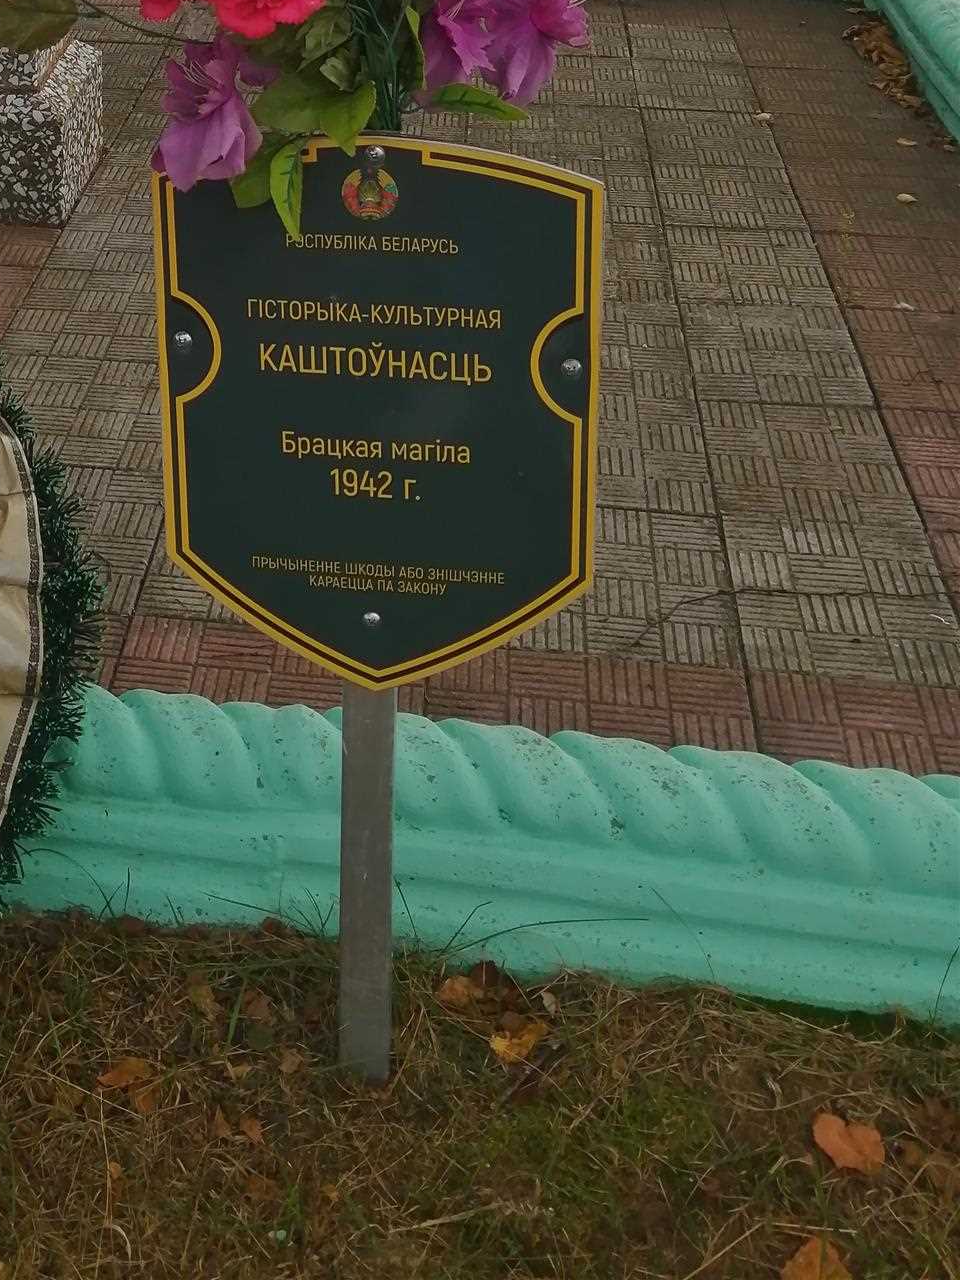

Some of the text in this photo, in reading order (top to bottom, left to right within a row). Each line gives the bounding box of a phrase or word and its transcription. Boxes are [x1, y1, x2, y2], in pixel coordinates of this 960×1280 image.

[382, 236, 459, 254] БЕЛАРУСЬ
[246, 298, 502, 329] ГІСТОРЫКА-КУЛЬТУРНАЯ
[259, 343, 492, 384] КАШТОЎНАСЦЬ
[281, 431, 471, 465] Брацкая магіла
[329, 469, 422, 501] 1942 г.
[252, 556, 505, 585] ПРЫЧЫНЕННЕ ШКОДЫ АБО ЗНІШЧЭННЕ
[309, 575, 446, 596] КАРАЕЦЦА ПА ЗАКОНУ
